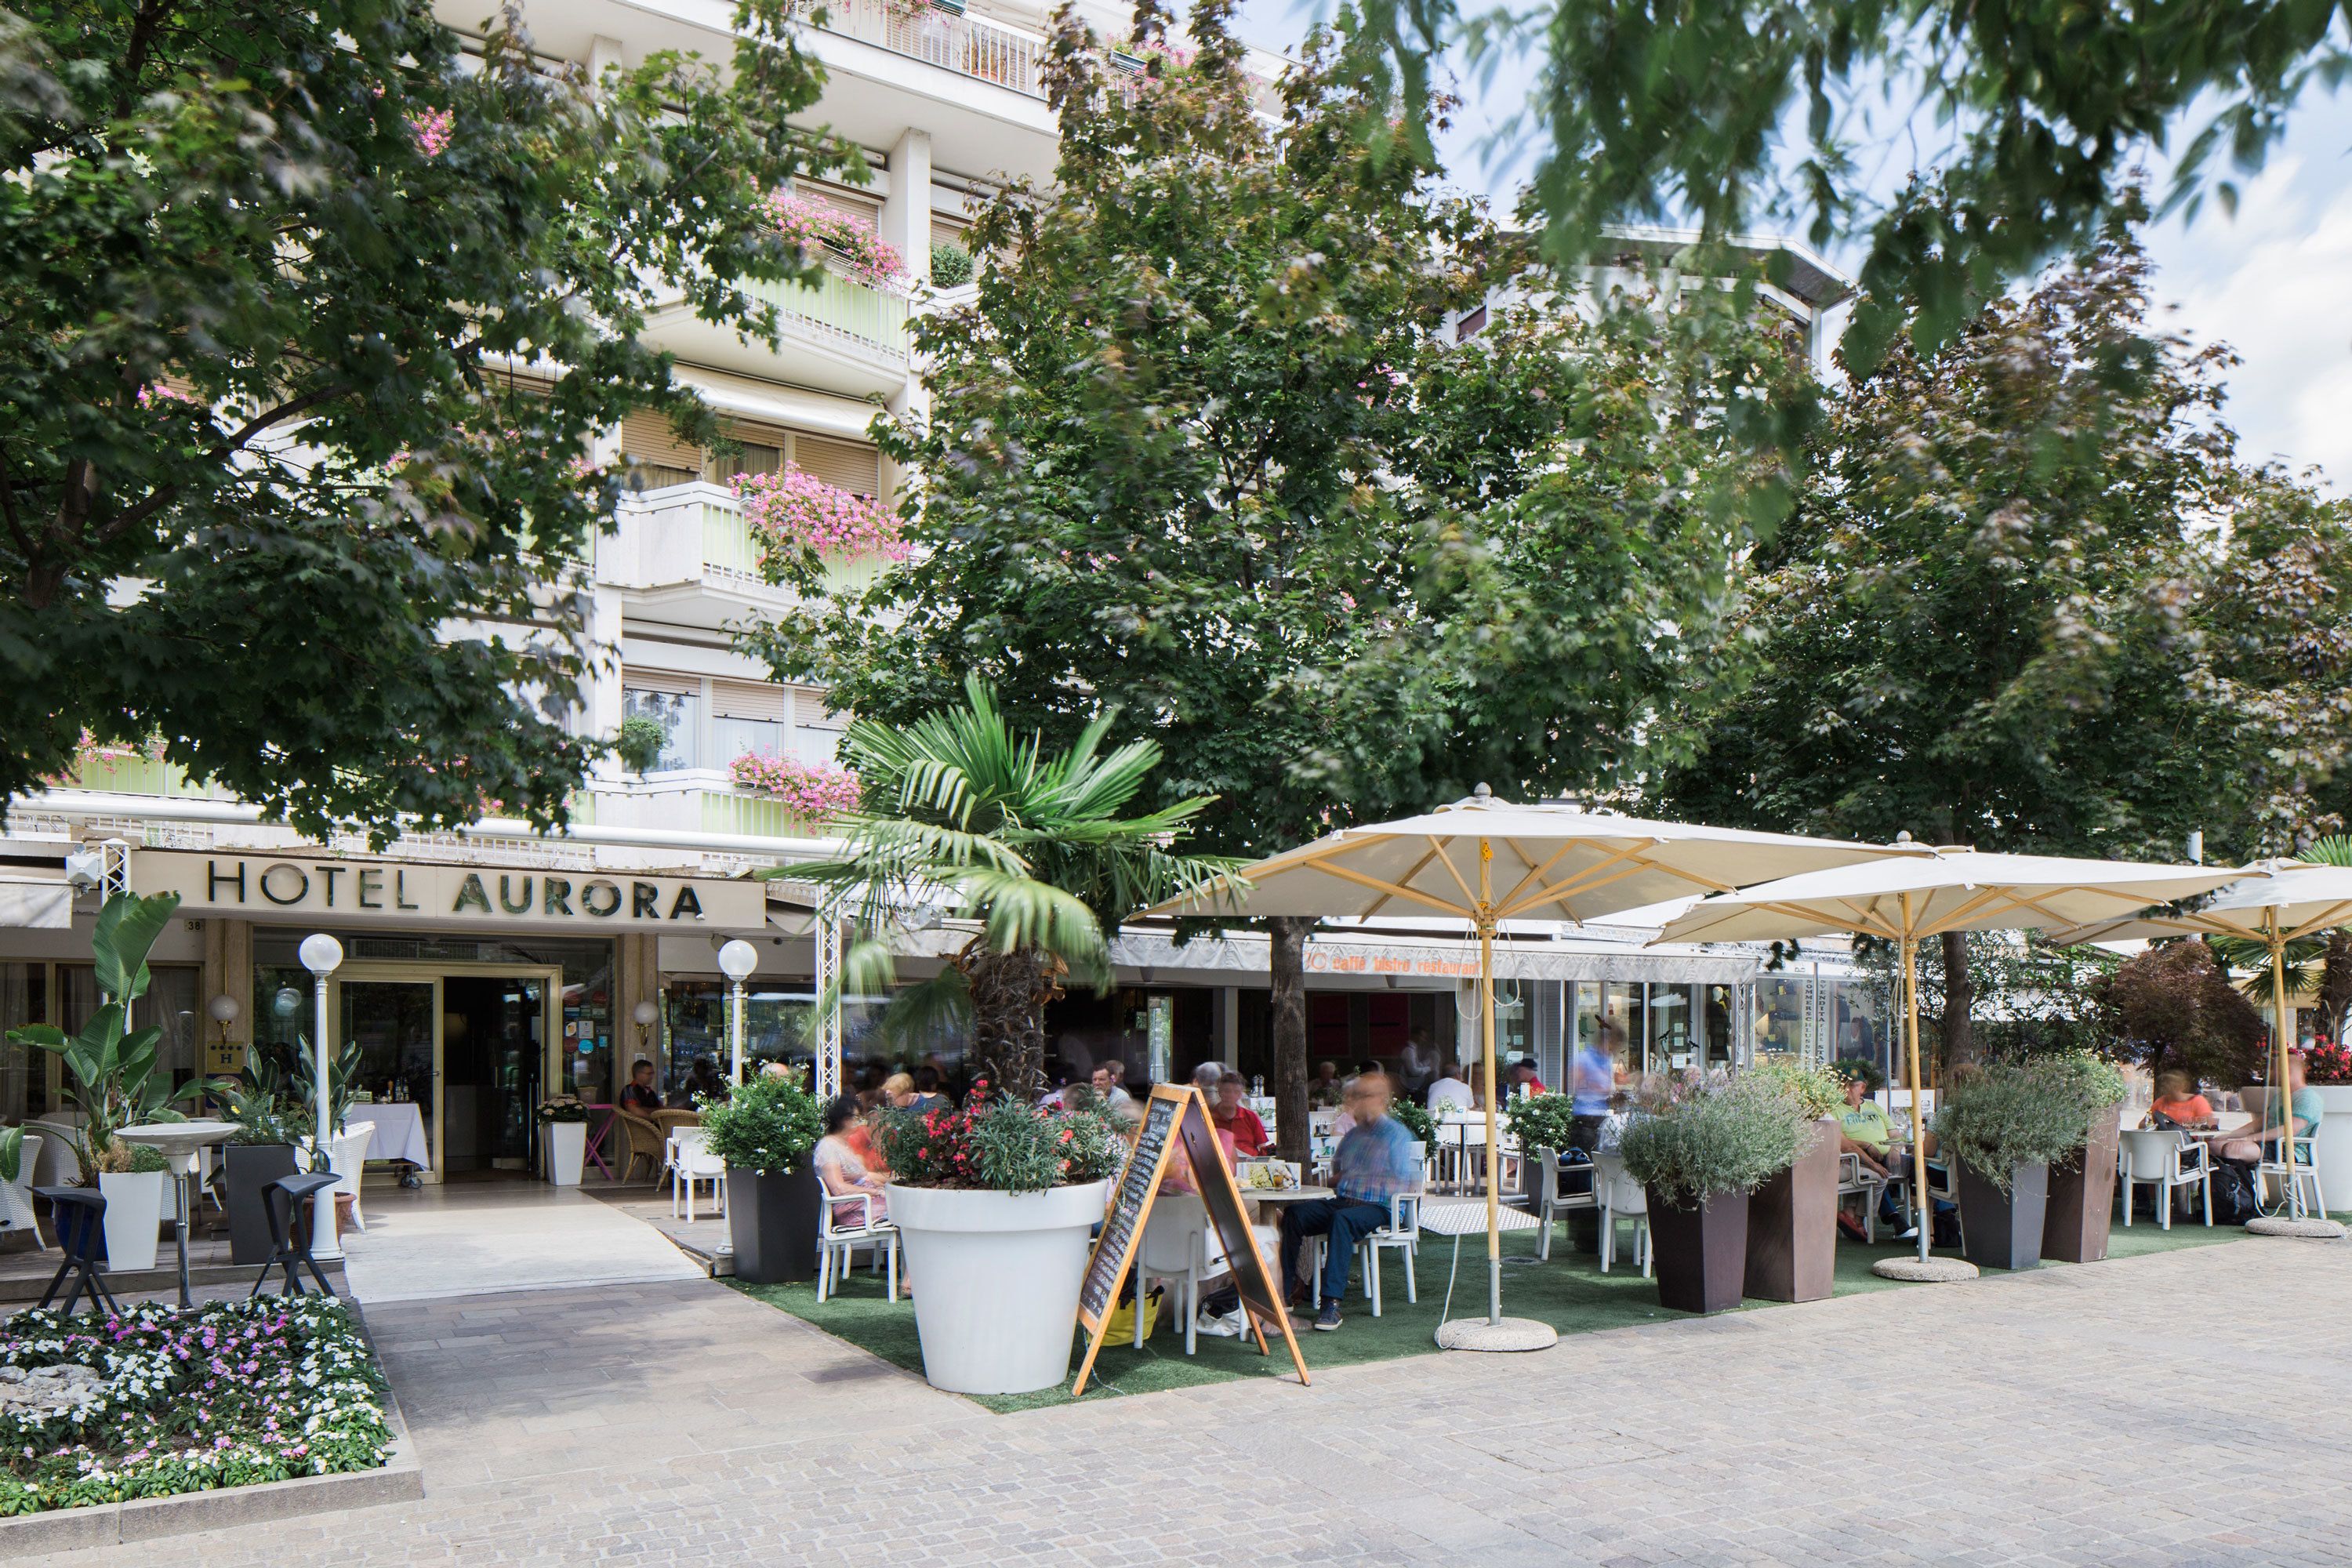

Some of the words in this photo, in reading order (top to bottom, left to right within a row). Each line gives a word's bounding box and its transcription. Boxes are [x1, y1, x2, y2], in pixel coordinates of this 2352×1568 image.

[208, 860, 419, 909] HOTEL
[452, 873, 706, 920] AURORA
[188, 921, 201, 931] 38
[220, 1054, 232, 1064] H
